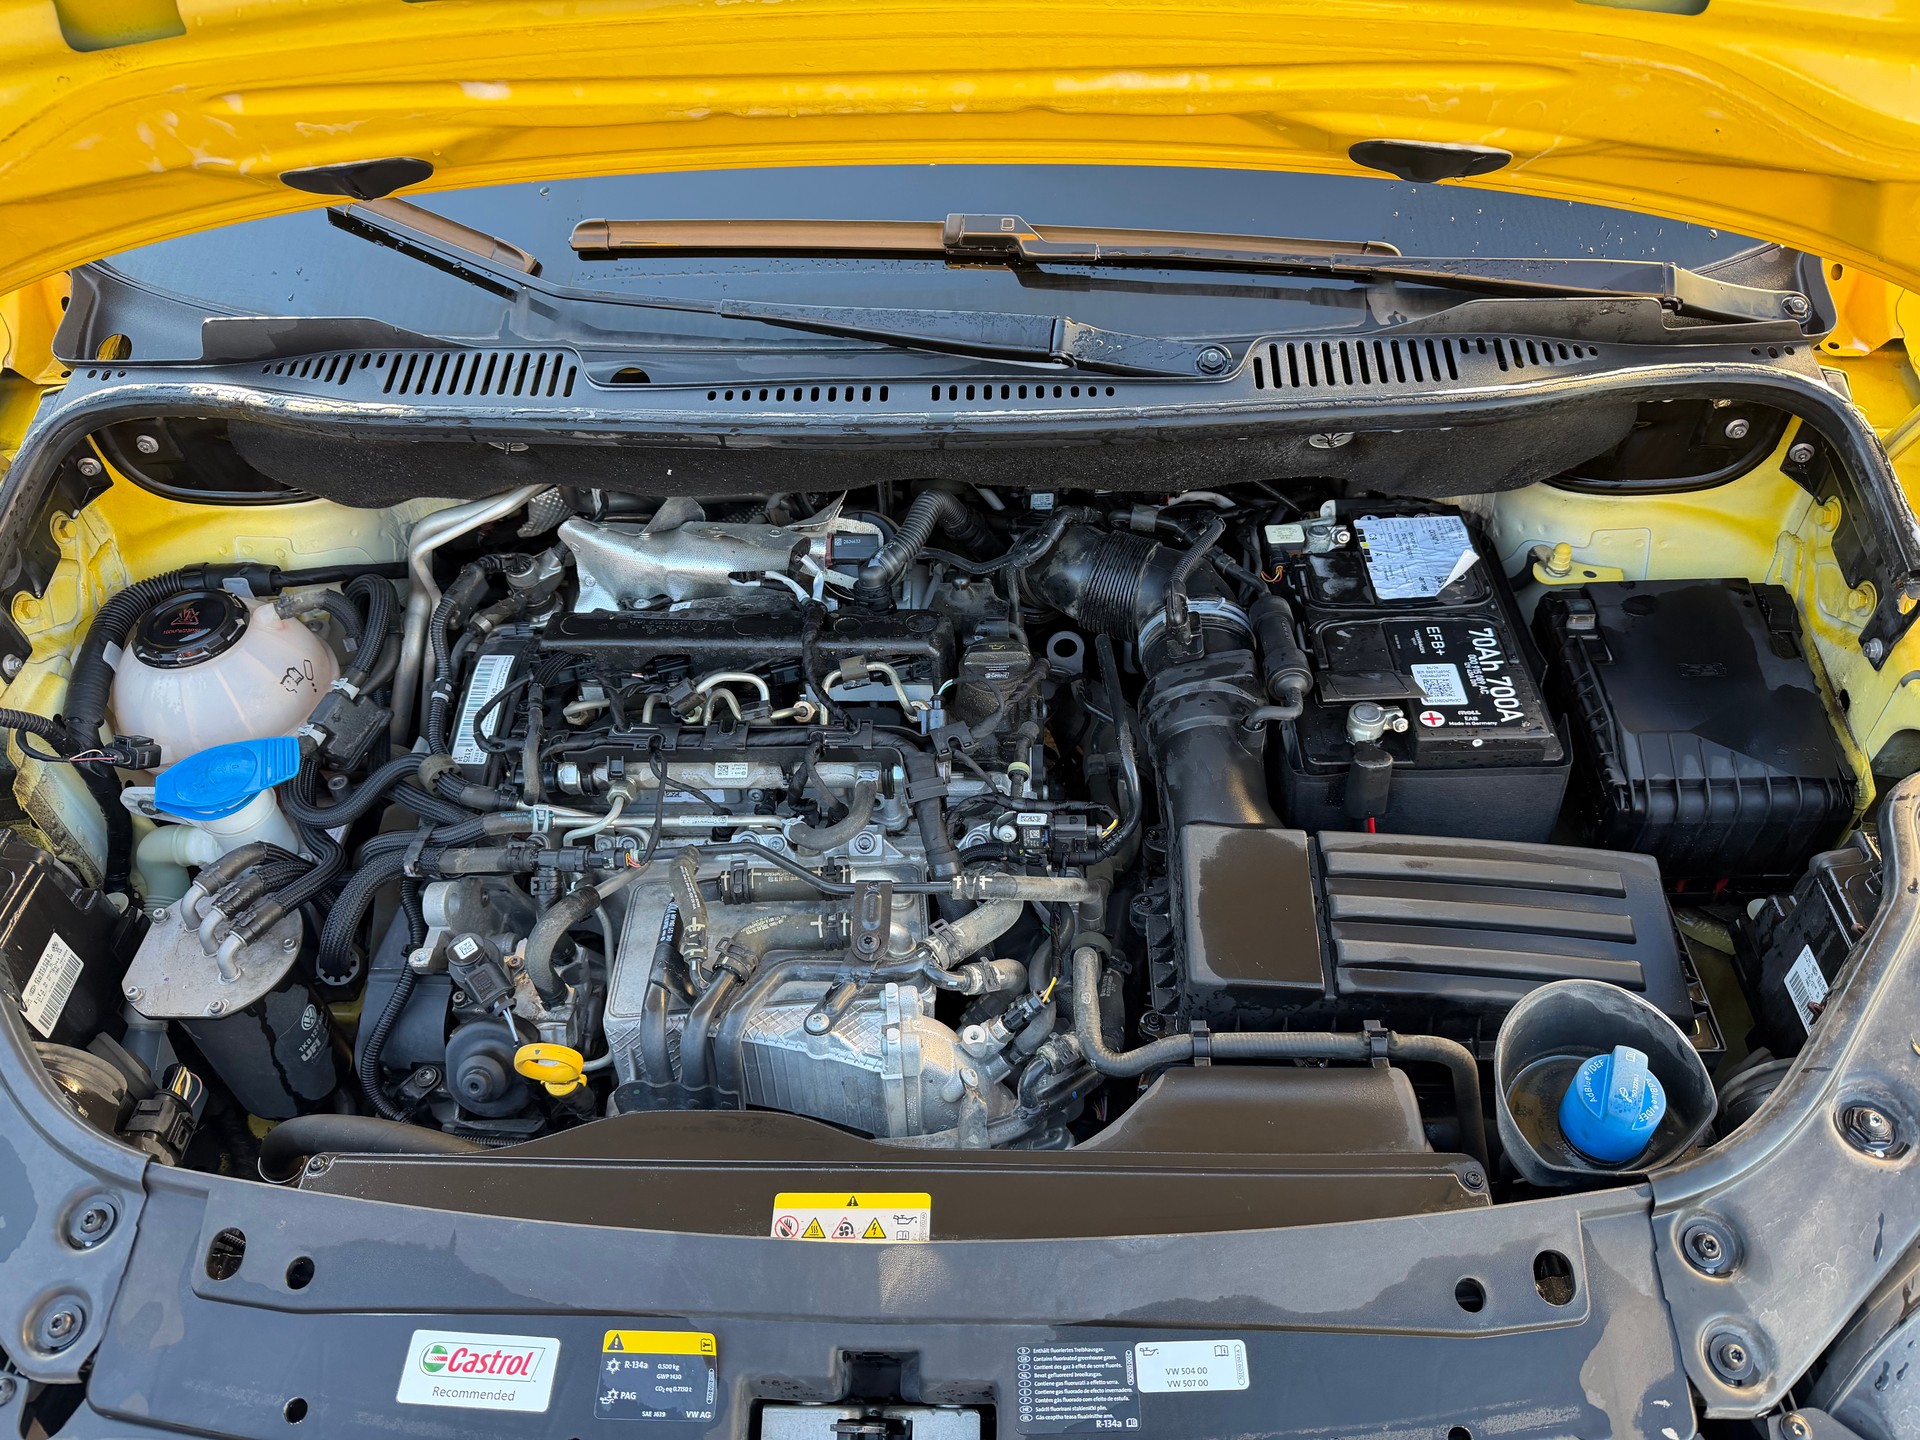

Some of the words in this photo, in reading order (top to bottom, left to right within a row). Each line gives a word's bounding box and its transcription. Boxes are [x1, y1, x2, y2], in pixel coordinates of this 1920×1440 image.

[1426, 627, 1445, 655] EFB+
[1468, 628, 1504, 672] 70Ah
[1486, 676, 1524, 722] 700A
[1479, 685, 1489, 695] AC
[301, 1038, 321, 1061] UFI
[448, 1347, 534, 1376] Castrol
[624, 1361, 648, 1369] R-134a
[432, 1386, 515, 1401] Recommended
[1096, 1420, 1122, 1428] R-134a
